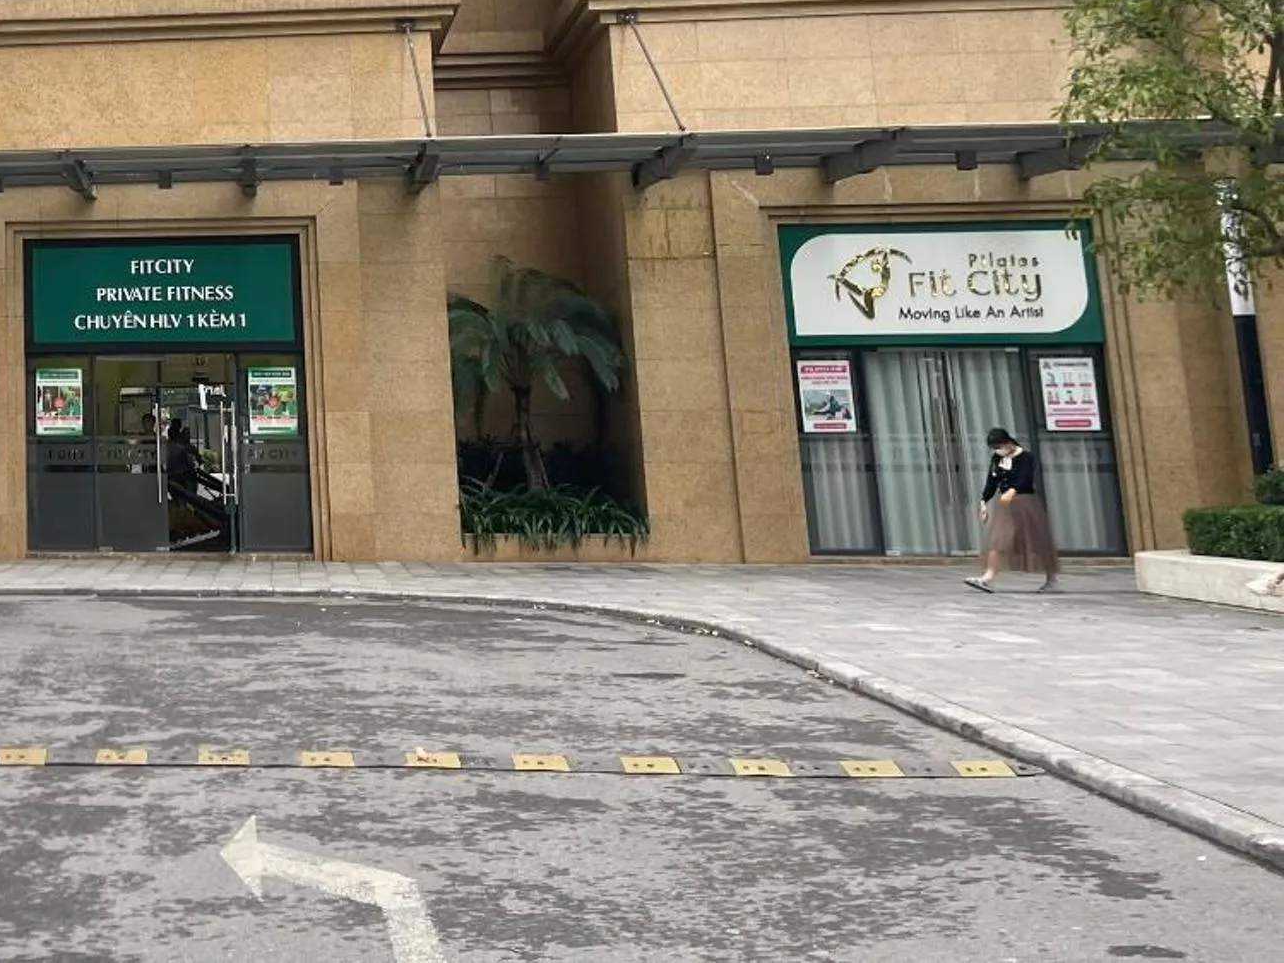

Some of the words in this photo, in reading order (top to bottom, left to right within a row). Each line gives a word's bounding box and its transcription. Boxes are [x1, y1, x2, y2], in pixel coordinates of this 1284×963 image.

[131, 259, 194, 275] FITCITY
[968, 251, 1039, 269] Pilates
[96, 286, 162, 302] PRIVATE
[166, 285, 233, 301] FITNESS
[908, 268, 957, 298] Fit
[967, 268, 1043, 302] City
[74, 310, 147, 330] CHUYÊN
[150, 313, 182, 329] HLV
[899, 306, 951, 323] Moving
[955, 306, 981, 320] Like
[986, 306, 1006, 320] An
[1011, 305, 1045, 319] Artist
